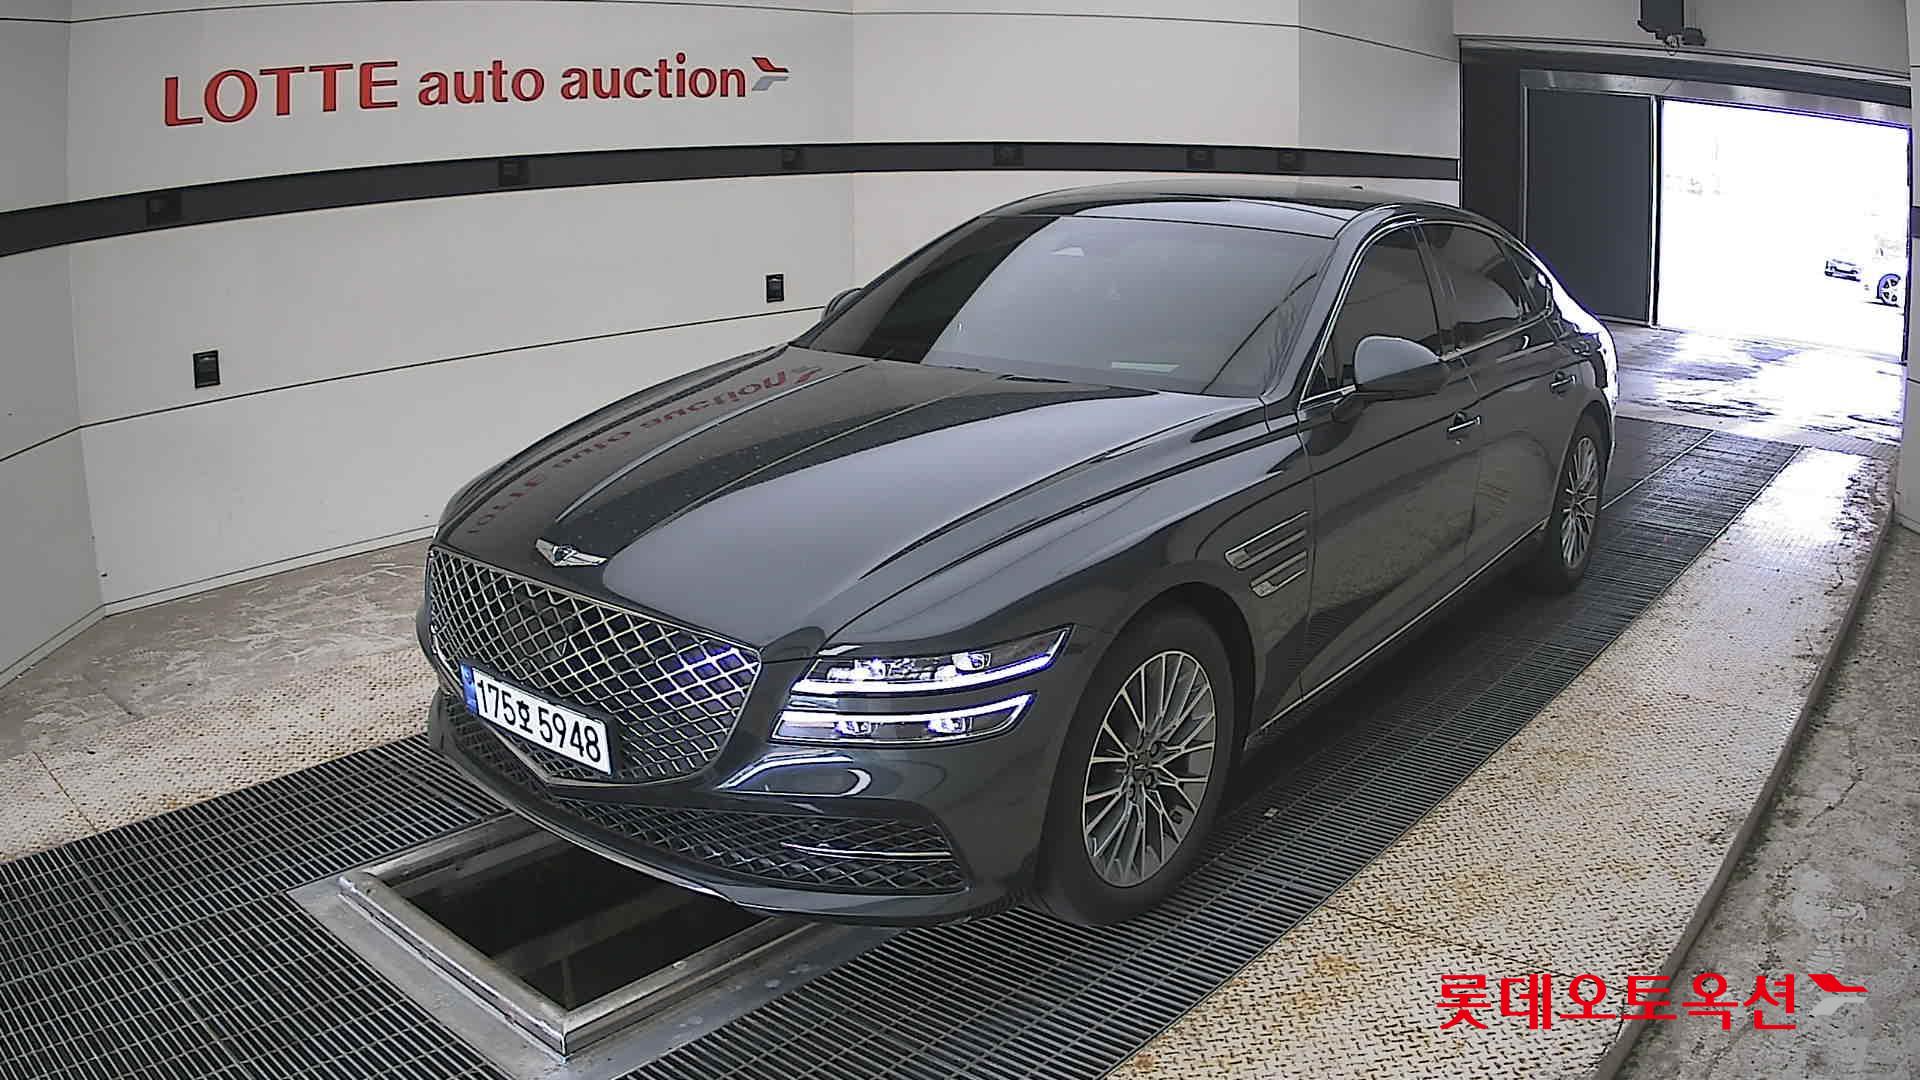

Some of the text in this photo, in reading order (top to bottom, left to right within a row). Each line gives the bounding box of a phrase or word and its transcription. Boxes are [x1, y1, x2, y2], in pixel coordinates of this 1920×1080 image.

[163, 52, 748, 127] LOTTE auto auction
[476, 679, 601, 763] 175호 5948
